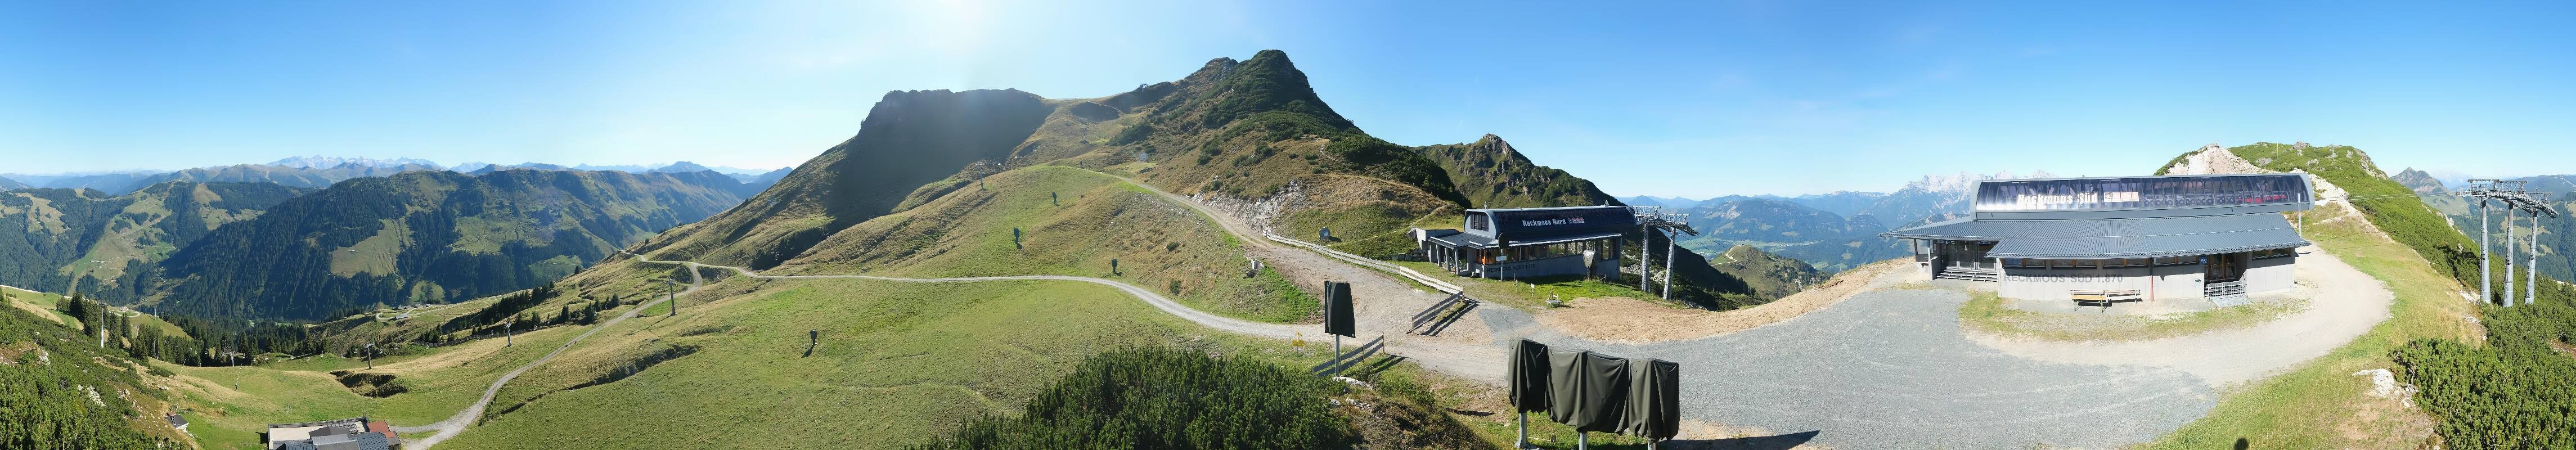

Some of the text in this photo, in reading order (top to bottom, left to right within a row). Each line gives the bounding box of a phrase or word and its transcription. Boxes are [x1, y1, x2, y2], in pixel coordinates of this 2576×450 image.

[2017, 194, 2073, 206] Reckmoos
[2078, 192, 2098, 204] Süd
[2004, 272, 2123, 283] RECKMOOS SÜD 1.870
